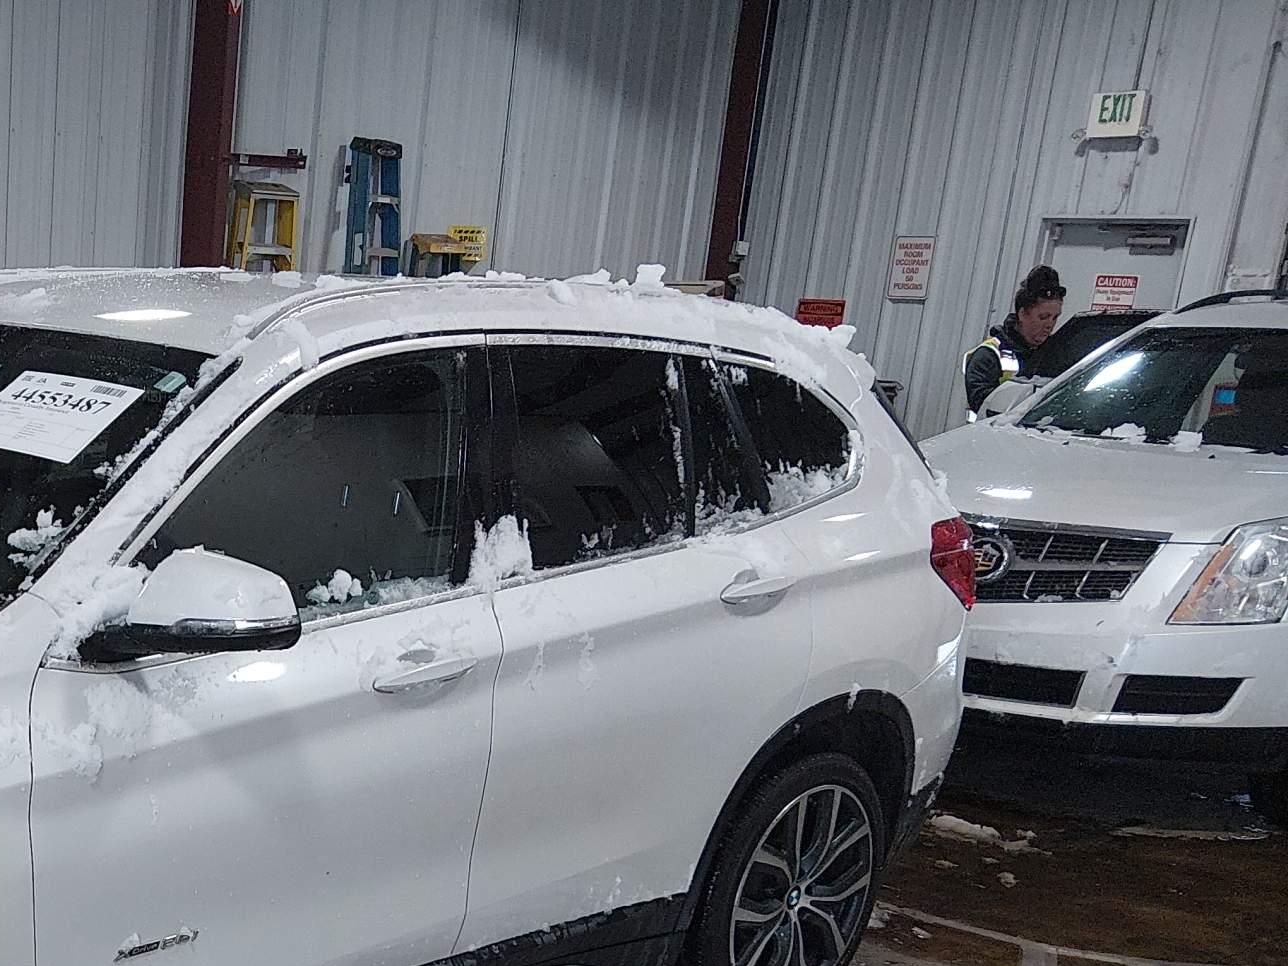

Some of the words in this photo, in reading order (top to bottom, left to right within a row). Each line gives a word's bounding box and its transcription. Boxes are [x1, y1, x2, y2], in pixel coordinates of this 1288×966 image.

[1098, 94, 1136, 123] EXIT
[1097, 277, 1137, 287] CAUTION:
[11, 387, 112, 415] 44553487
